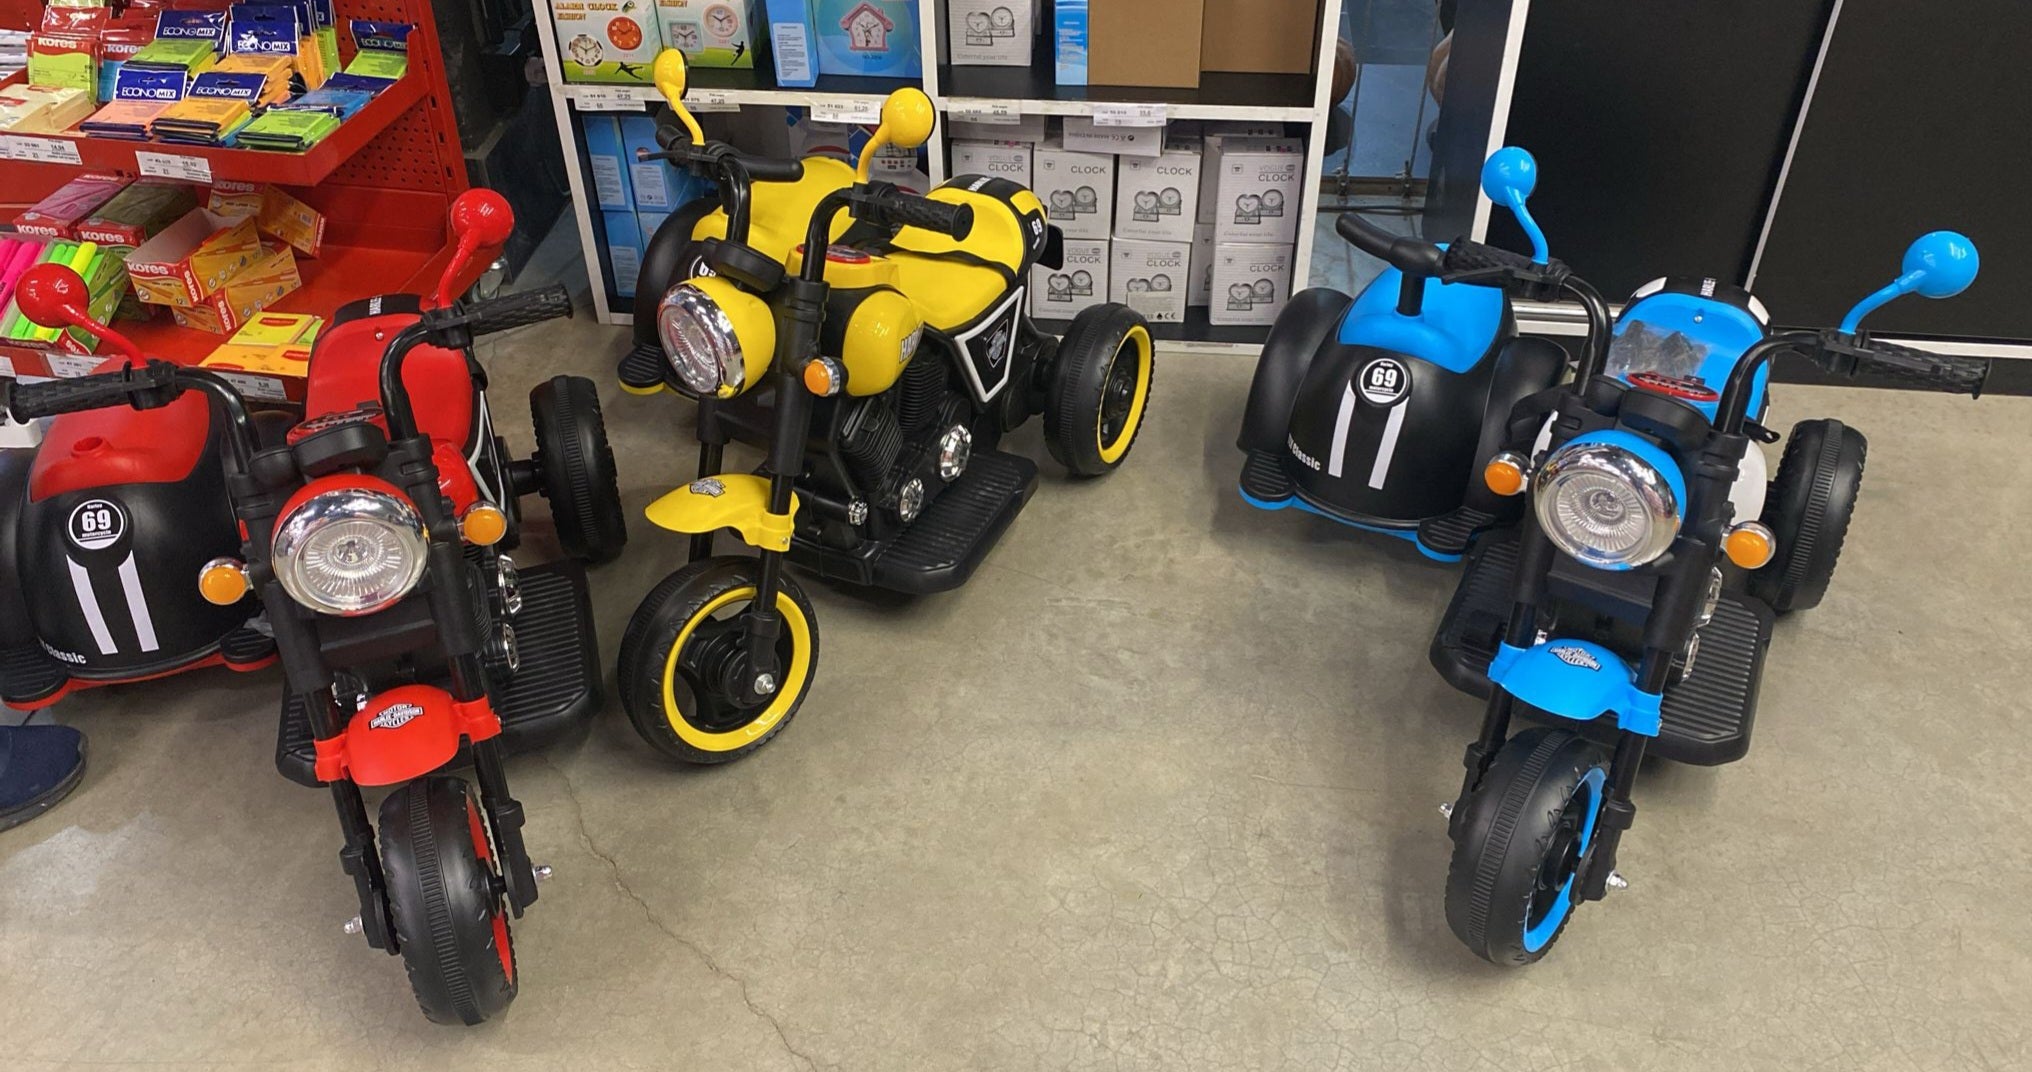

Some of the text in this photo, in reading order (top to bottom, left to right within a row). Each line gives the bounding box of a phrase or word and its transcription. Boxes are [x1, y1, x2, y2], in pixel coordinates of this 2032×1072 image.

[163, 27, 215, 36] ECONO MIX
[237, 40, 289, 50] ECONO MIX
[122, 87, 176, 98] ECONO MIX
[196, 87, 251, 96] ECONO MIX
[988, 163, 1024, 172] CLOCK
[1070, 165, 1106, 174] CLOCK
[1156, 166, 1192, 176] CLOCK
[1258, 173, 1295, 182] CLOCK
[1067, 255, 1101, 264] CLOCK
[1249, 264, 1285, 273] CLOCK
[1371, 367, 1397, 387] 69
[1292, 442, 1320, 470] Classic
[81, 509, 111, 532] 69
